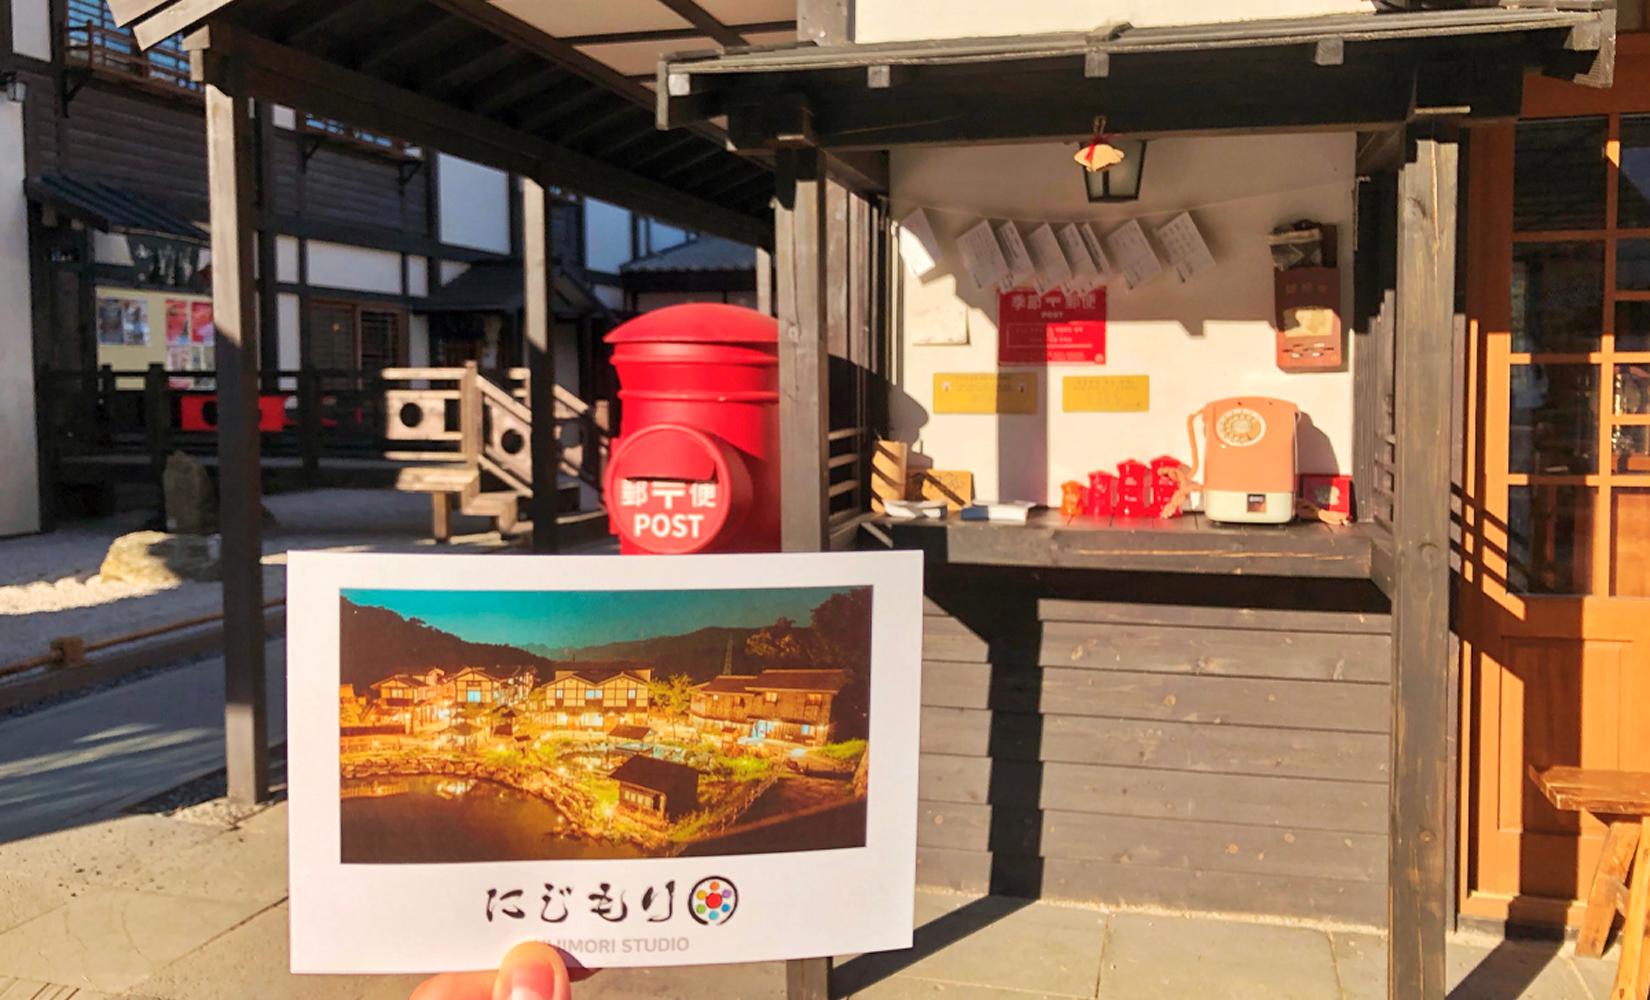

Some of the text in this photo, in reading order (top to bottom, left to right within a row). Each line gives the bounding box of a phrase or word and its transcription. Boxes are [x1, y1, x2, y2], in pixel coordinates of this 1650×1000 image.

[1041, 311, 1064, 319] POST
[634, 513, 704, 539] POST
[486, 880, 675, 923] にじもり
[621, 937, 689, 953] STUDIO
